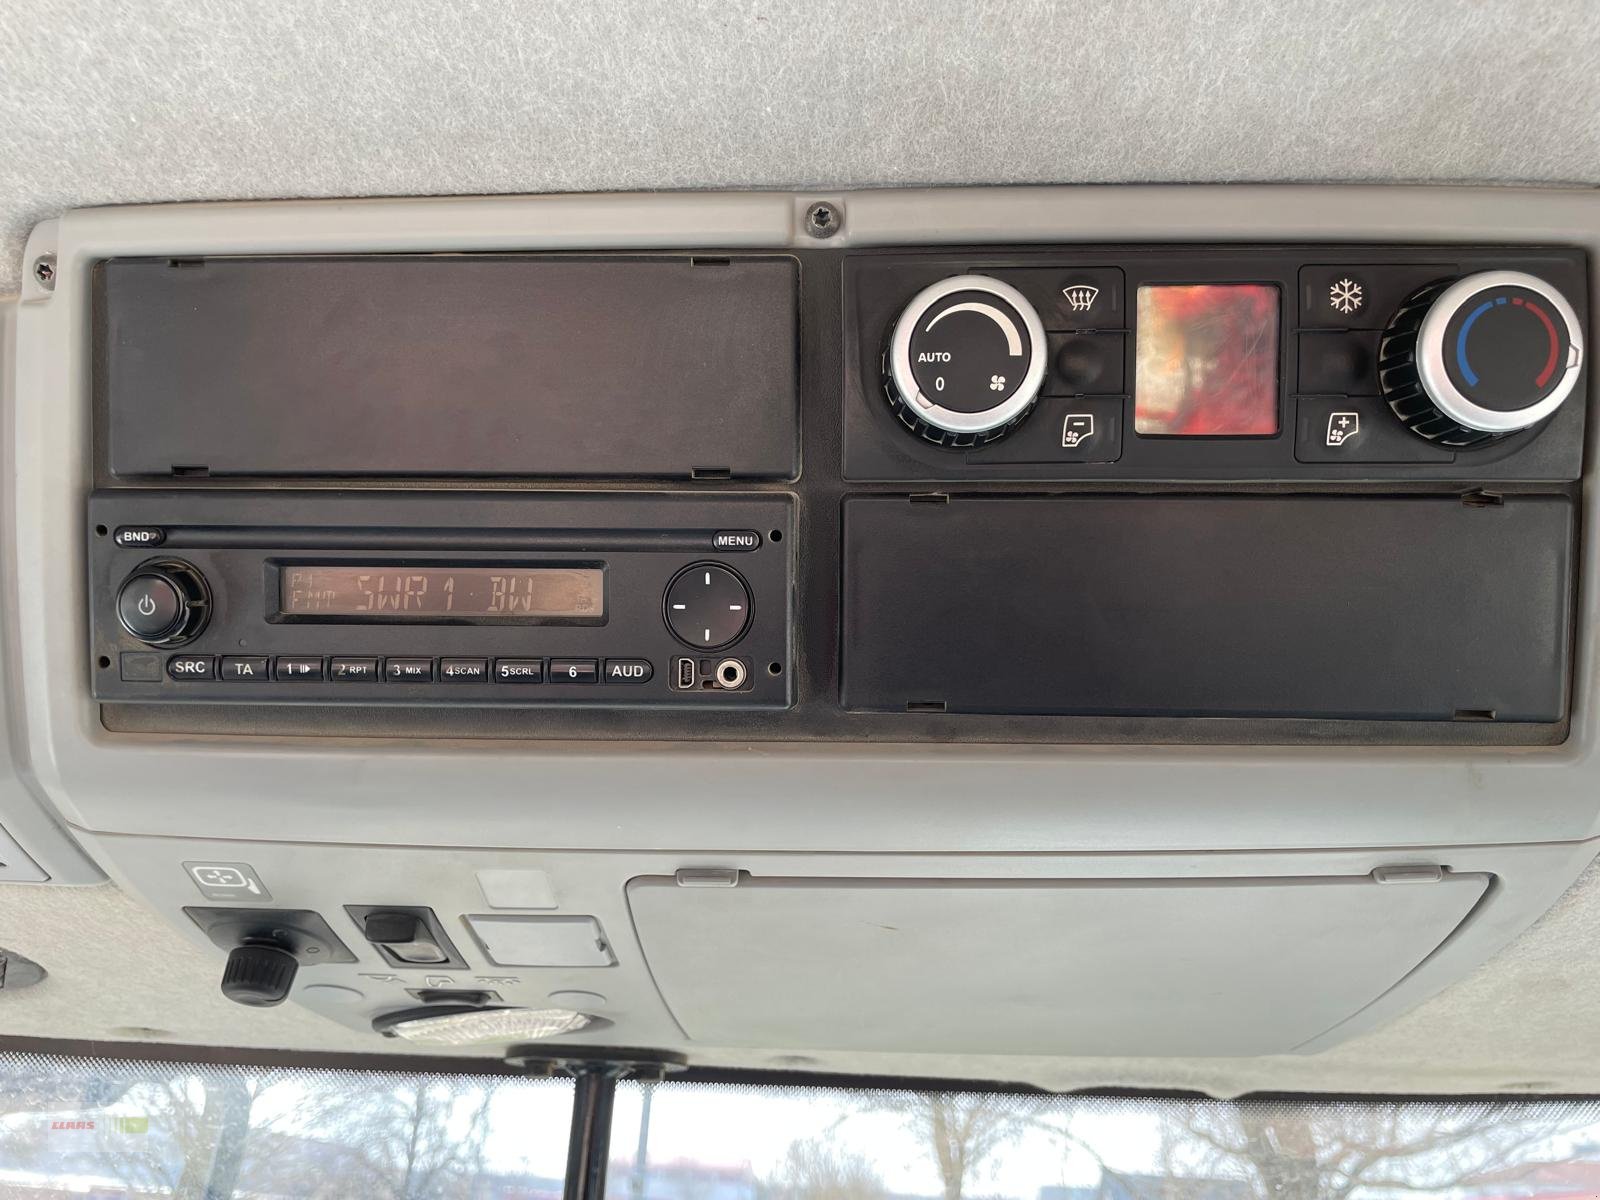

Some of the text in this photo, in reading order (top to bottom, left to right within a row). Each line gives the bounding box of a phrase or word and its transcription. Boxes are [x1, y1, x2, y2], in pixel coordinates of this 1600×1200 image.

[917, 352, 952, 363] AUTO
[935, 376, 945, 392] 0
[123, 531, 150, 543] BND
[717, 535, 754, 547] MENU
[356, 575, 428, 611] SWR
[443, 576, 455, 612] 1
[487, 576, 534, 612] BW
[174, 660, 206, 674] SRC
[234, 663, 254, 675] TA
[286, 663, 293, 675] 1
[349, 666, 368, 674] RPT
[405, 666, 422, 675] MIX
[568, 665, 578, 678] 6
[611, 665, 645, 678] AUD
